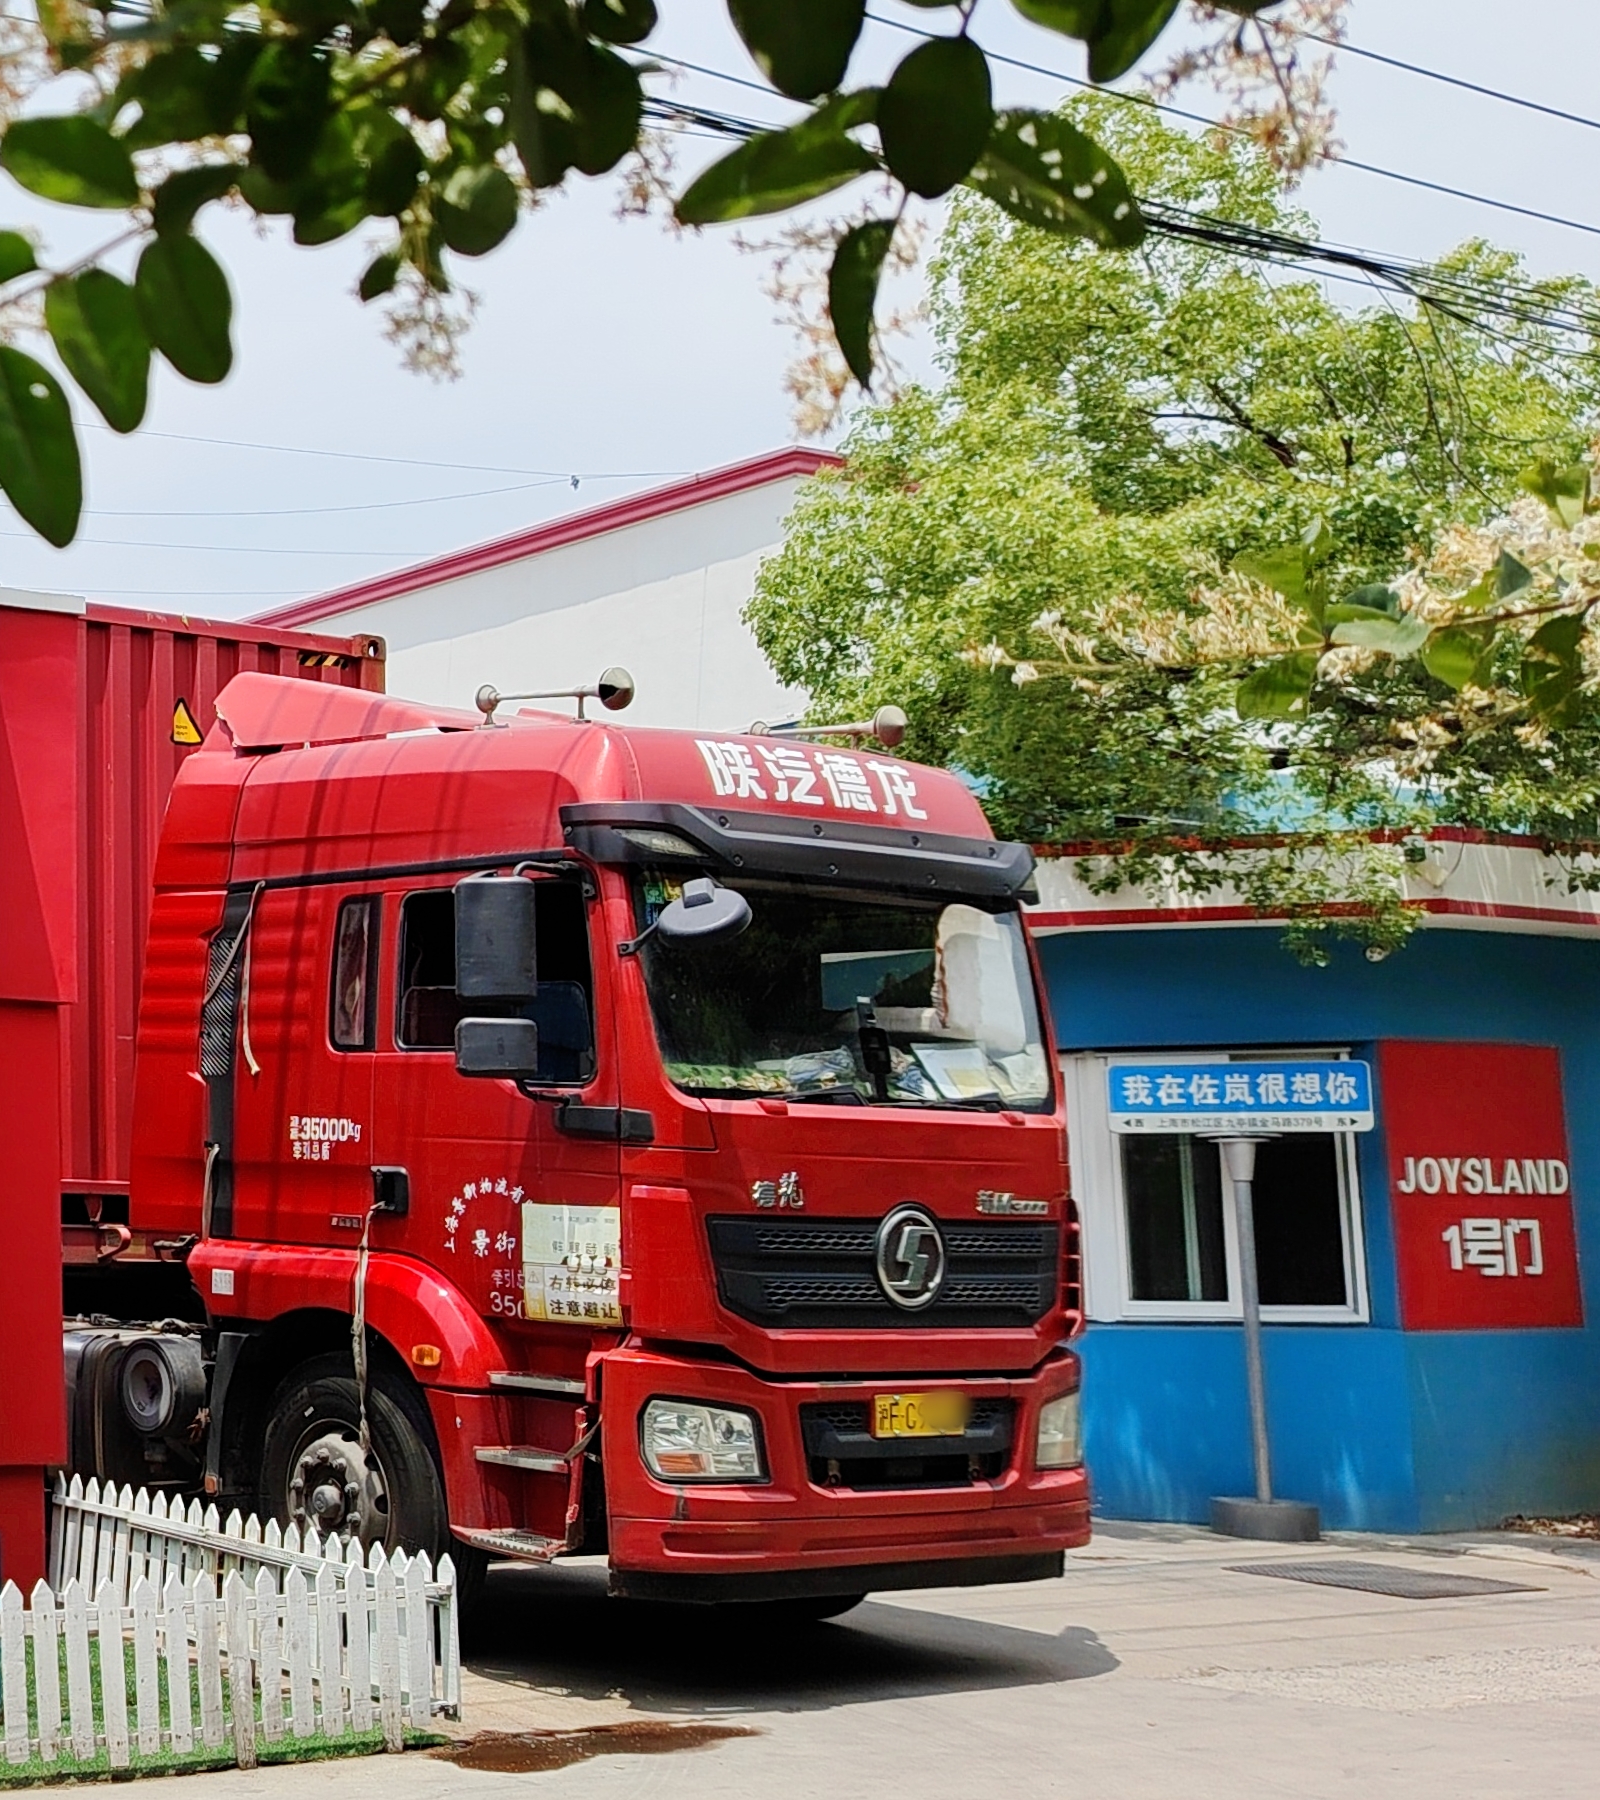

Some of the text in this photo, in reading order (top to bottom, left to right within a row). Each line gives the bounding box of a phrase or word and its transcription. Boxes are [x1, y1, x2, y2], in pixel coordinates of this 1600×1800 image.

[694, 738, 928, 820] 陕汽德龙
[1121, 1072, 1359, 1106] 我在佐岚很想你
[1397, 1156, 1570, 1195] JOYSLAND
[1441, 1217, 1544, 1277] 1号门
[549, 1299, 619, 1320] 注意避让
